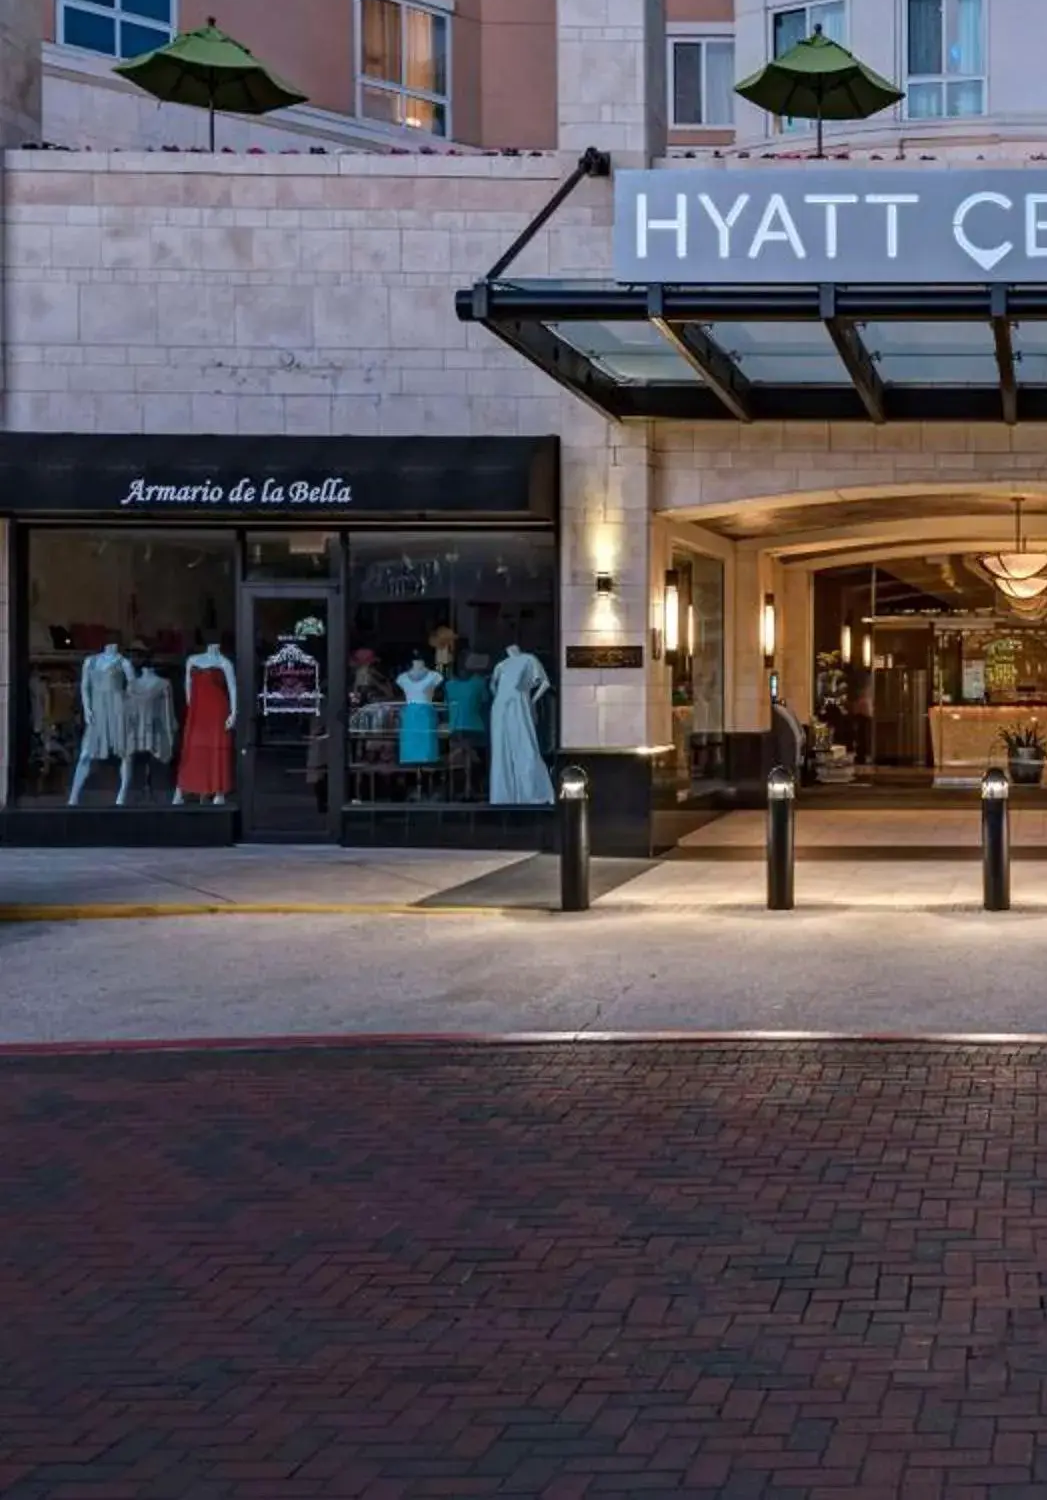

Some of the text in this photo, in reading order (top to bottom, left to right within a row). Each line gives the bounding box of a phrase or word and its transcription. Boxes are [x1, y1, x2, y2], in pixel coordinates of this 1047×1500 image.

[635, 192, 920, 259] HYATT
[120, 477, 353, 505] Armario de la Bella
